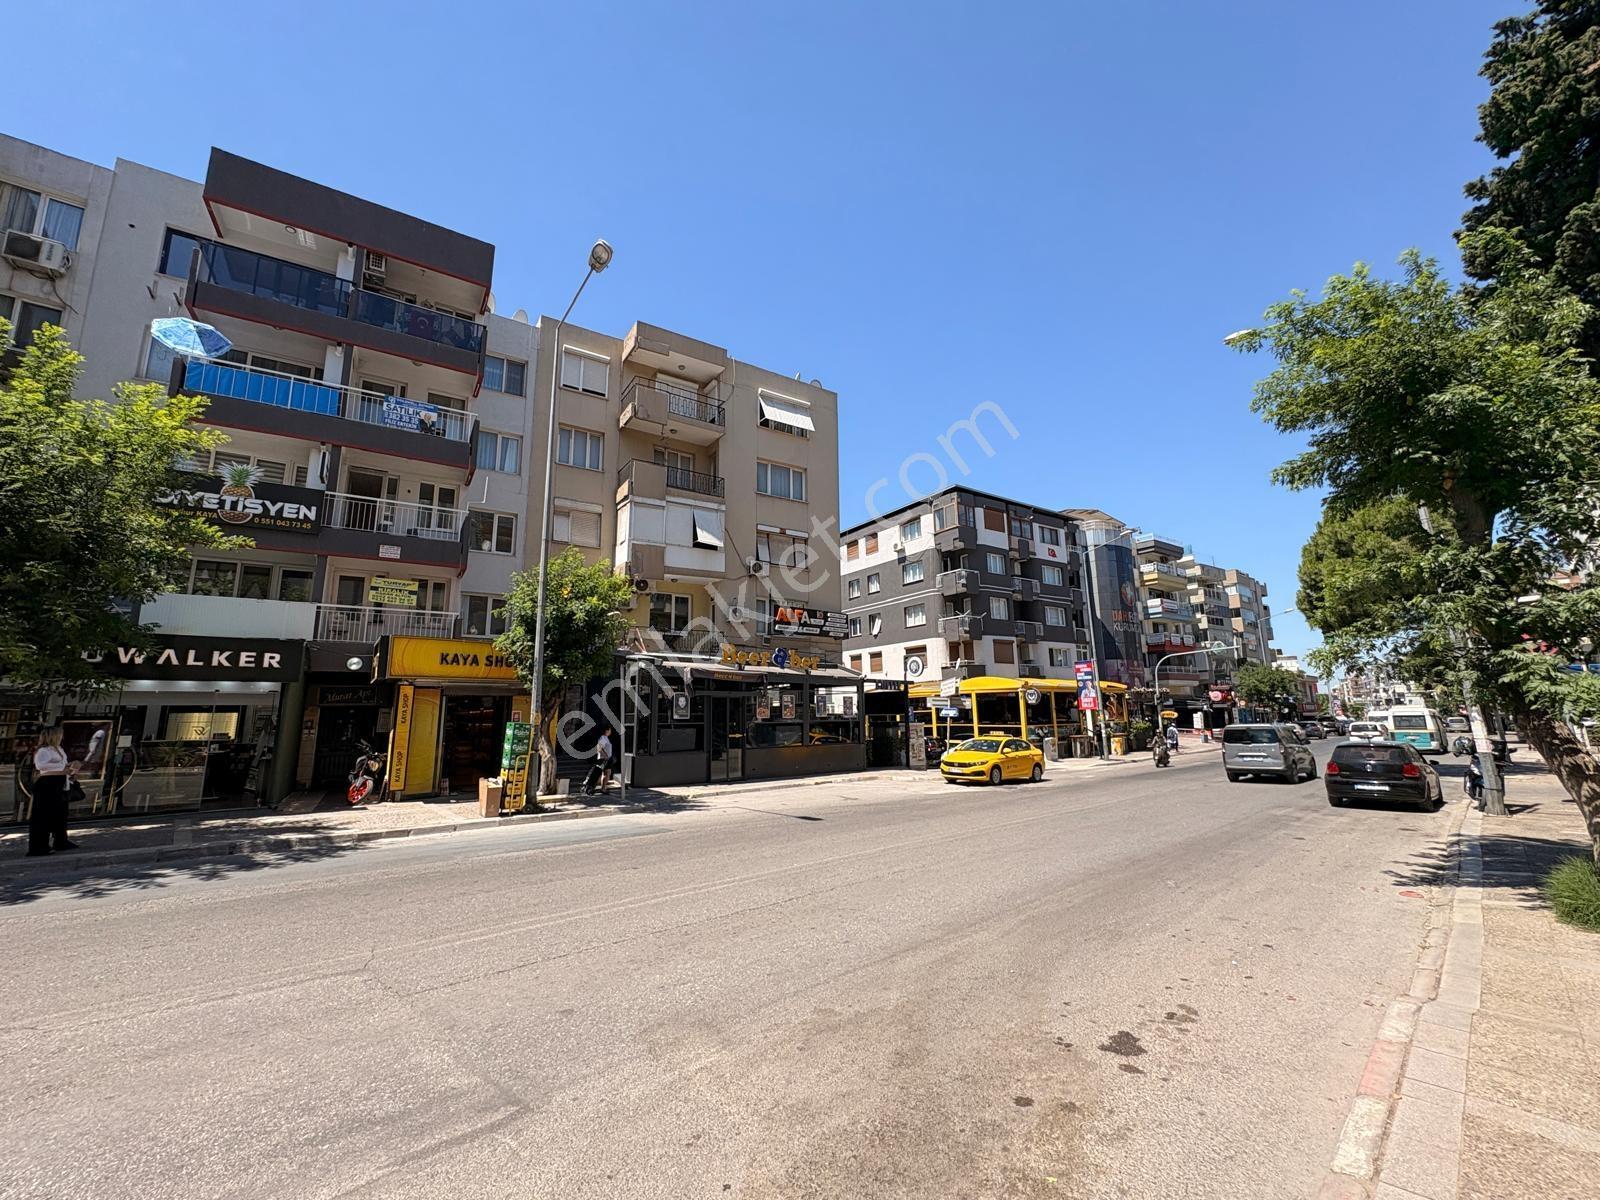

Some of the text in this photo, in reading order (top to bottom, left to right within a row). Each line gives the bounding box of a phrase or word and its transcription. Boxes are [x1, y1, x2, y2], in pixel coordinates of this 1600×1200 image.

[197, 510, 218, 519] KAYA
[302, 522, 312, 530] 45
[776, 607, 811, 624] ALFA
[440, 652, 515, 668] KAYA SHO
